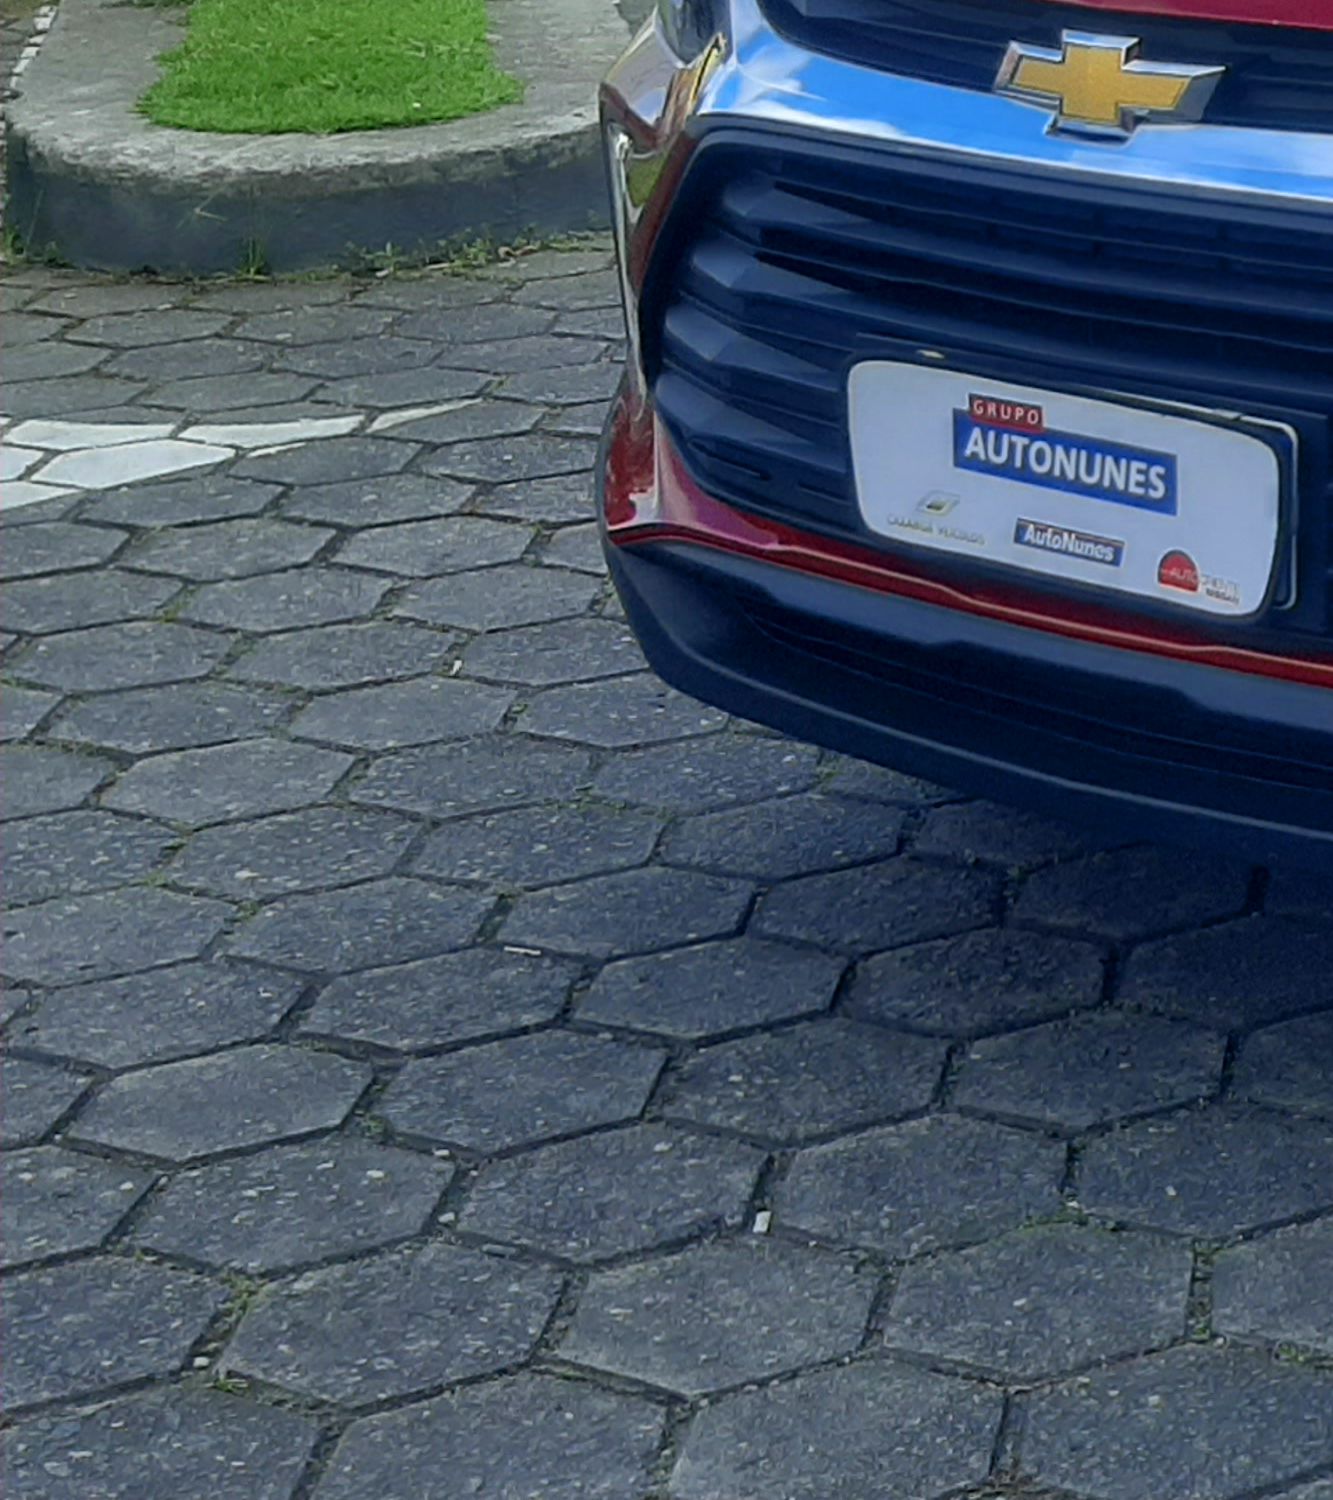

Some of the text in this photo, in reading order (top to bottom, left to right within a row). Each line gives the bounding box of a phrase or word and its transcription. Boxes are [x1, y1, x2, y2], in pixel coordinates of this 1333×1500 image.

[973, 398, 1040, 425] GRUPO
[964, 426, 1167, 499] AUTONUNES
[1023, 523, 1115, 561] AutoNunes
